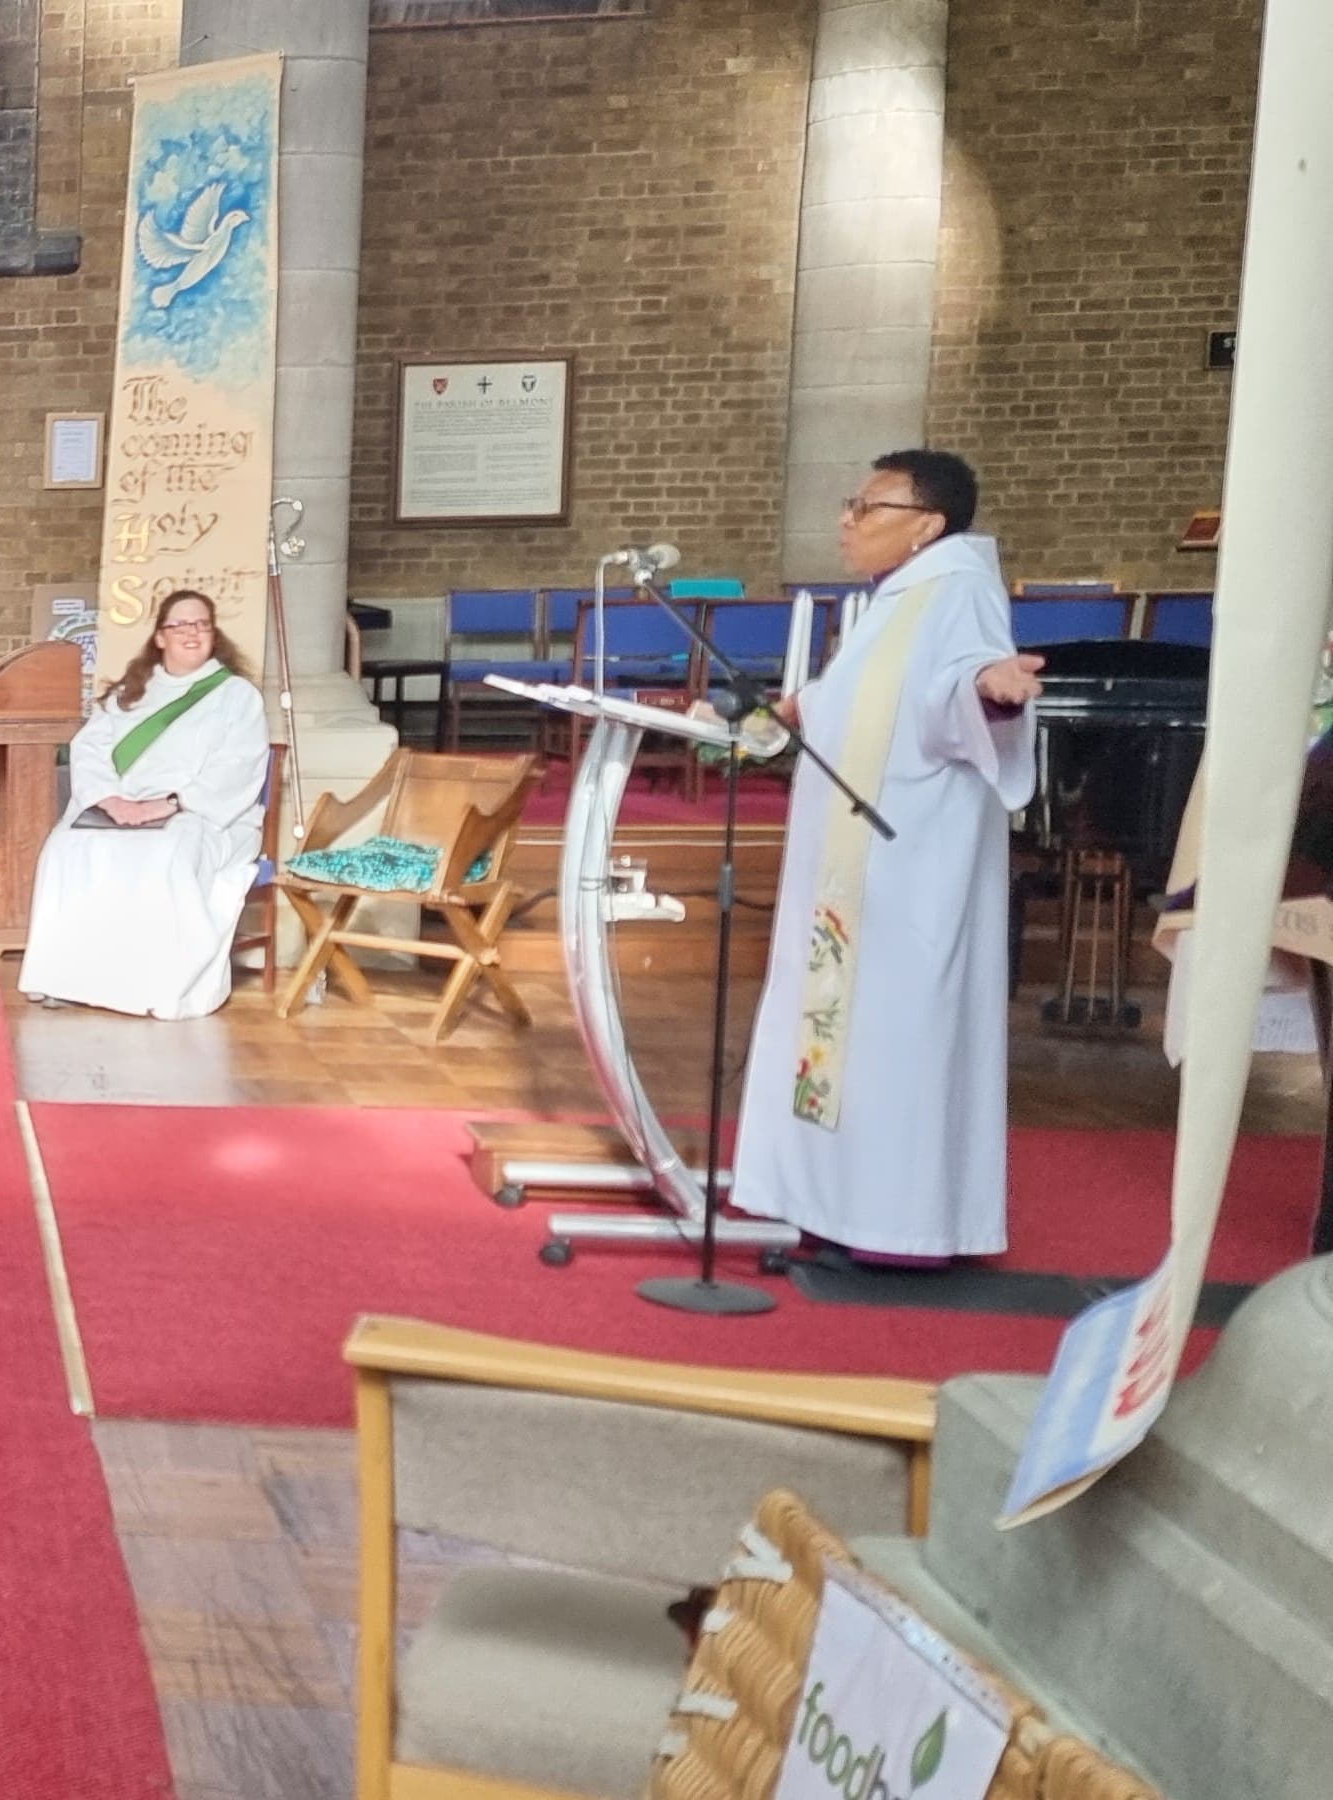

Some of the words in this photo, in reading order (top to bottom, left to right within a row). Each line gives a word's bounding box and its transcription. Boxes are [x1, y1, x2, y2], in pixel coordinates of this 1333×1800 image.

[123, 375, 188, 426] The
[120, 423, 253, 461] coming
[798, 1681, 903, 1800] foodb
